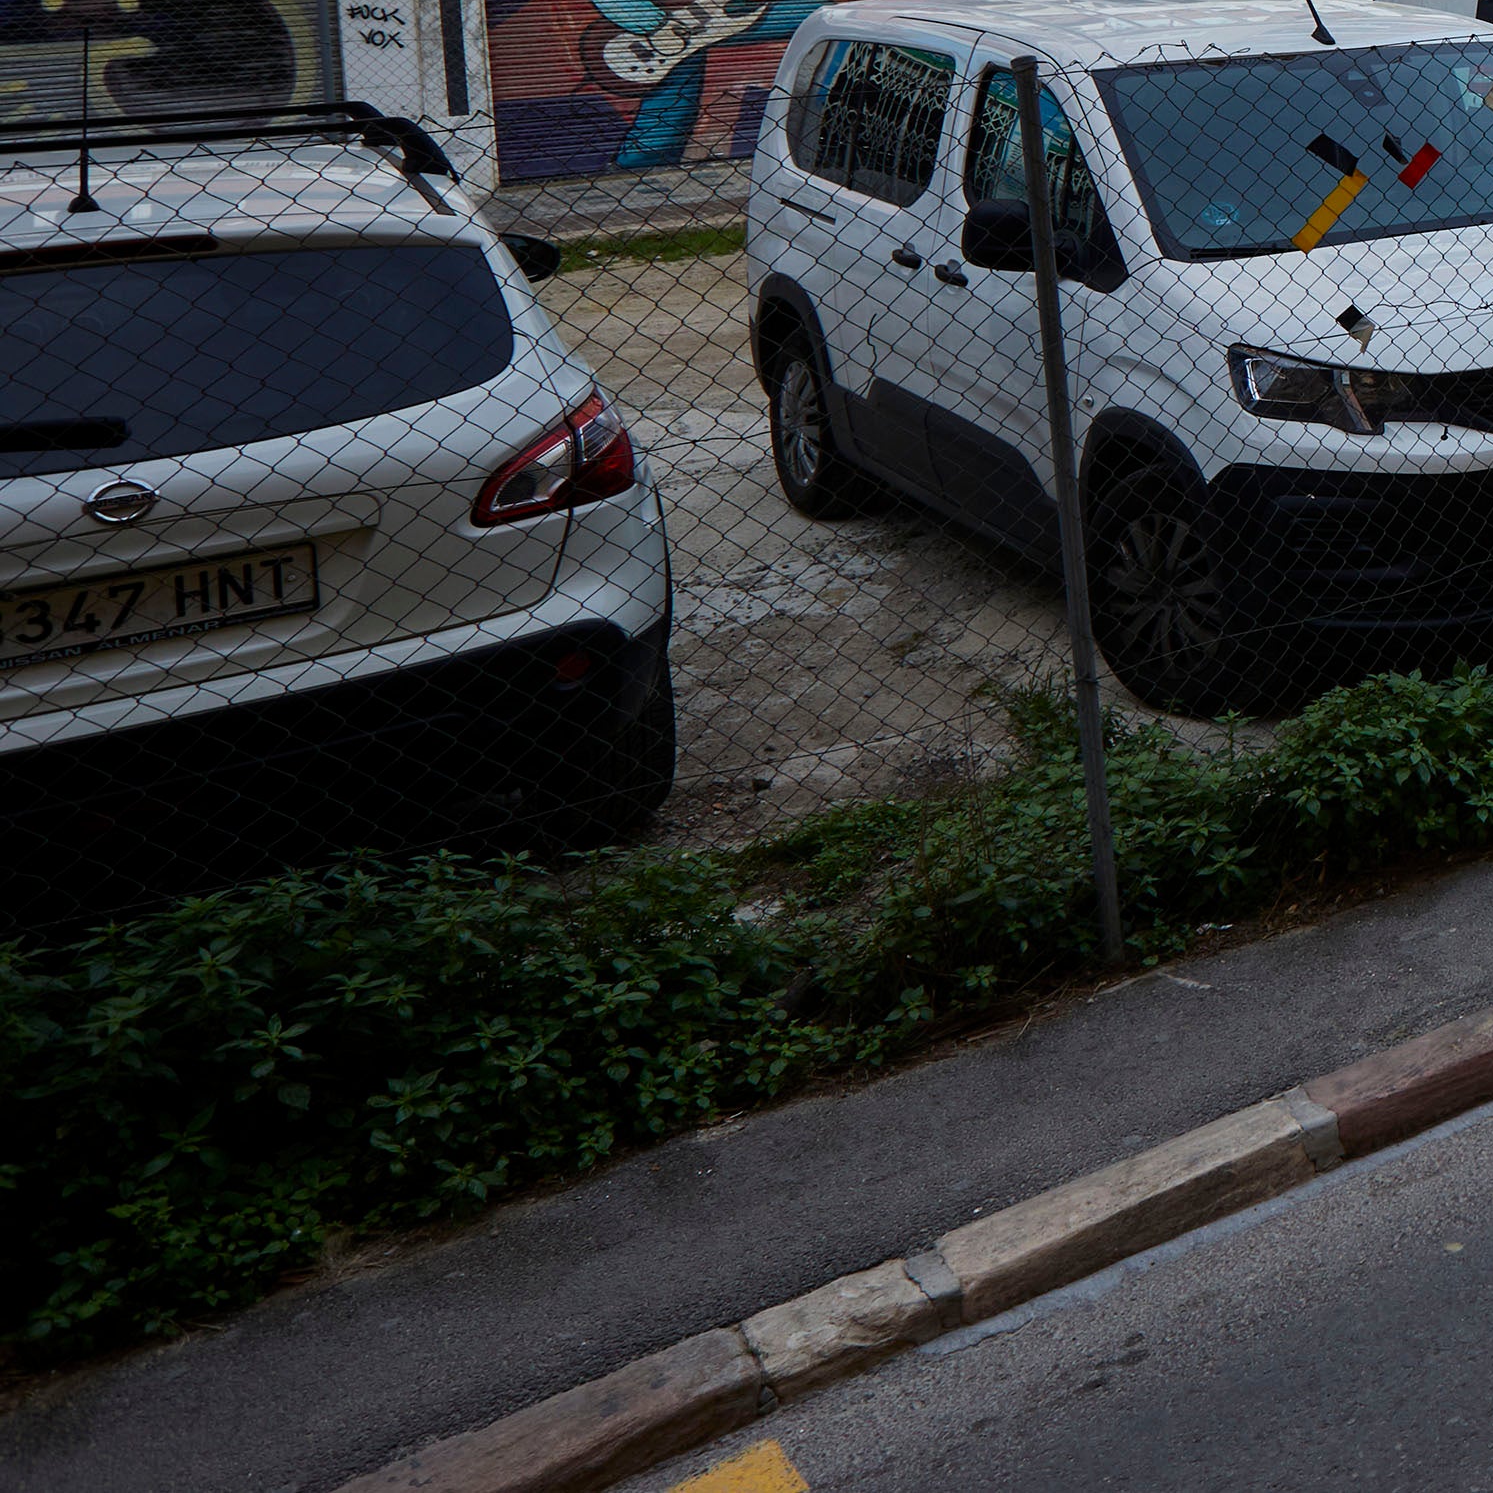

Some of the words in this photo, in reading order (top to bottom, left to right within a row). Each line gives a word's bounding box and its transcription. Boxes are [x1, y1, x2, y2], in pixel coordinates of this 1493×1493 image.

[358, 29, 405, 49] VOX
[0, 581, 146, 648] 347
[174, 556, 294, 618] HNT
[97, 620, 221, 651] ALMENAR
